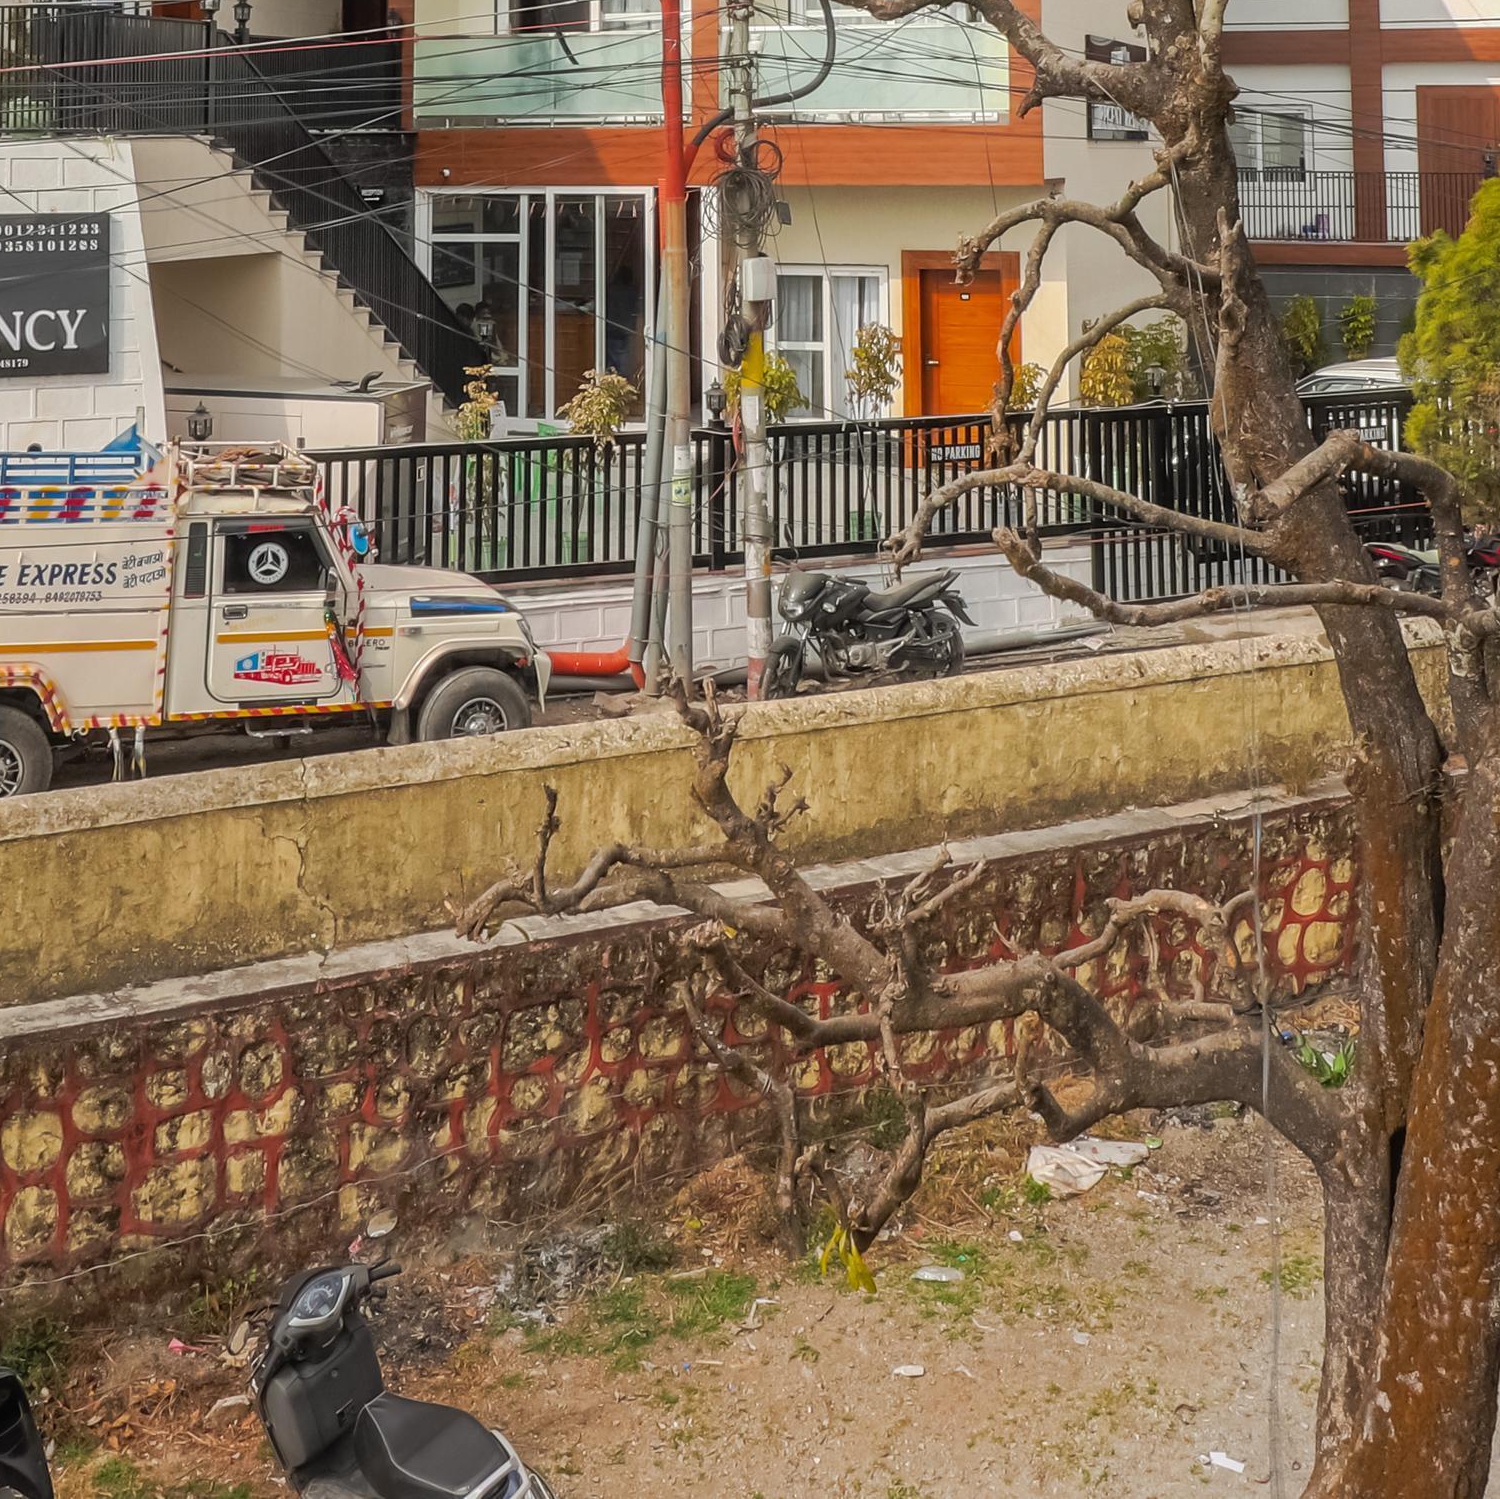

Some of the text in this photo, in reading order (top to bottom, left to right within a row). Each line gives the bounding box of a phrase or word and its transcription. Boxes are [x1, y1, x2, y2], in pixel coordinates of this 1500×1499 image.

[931, 445, 980, 461] NO PARKING
[17, 563, 117, 586] EXPRESS
